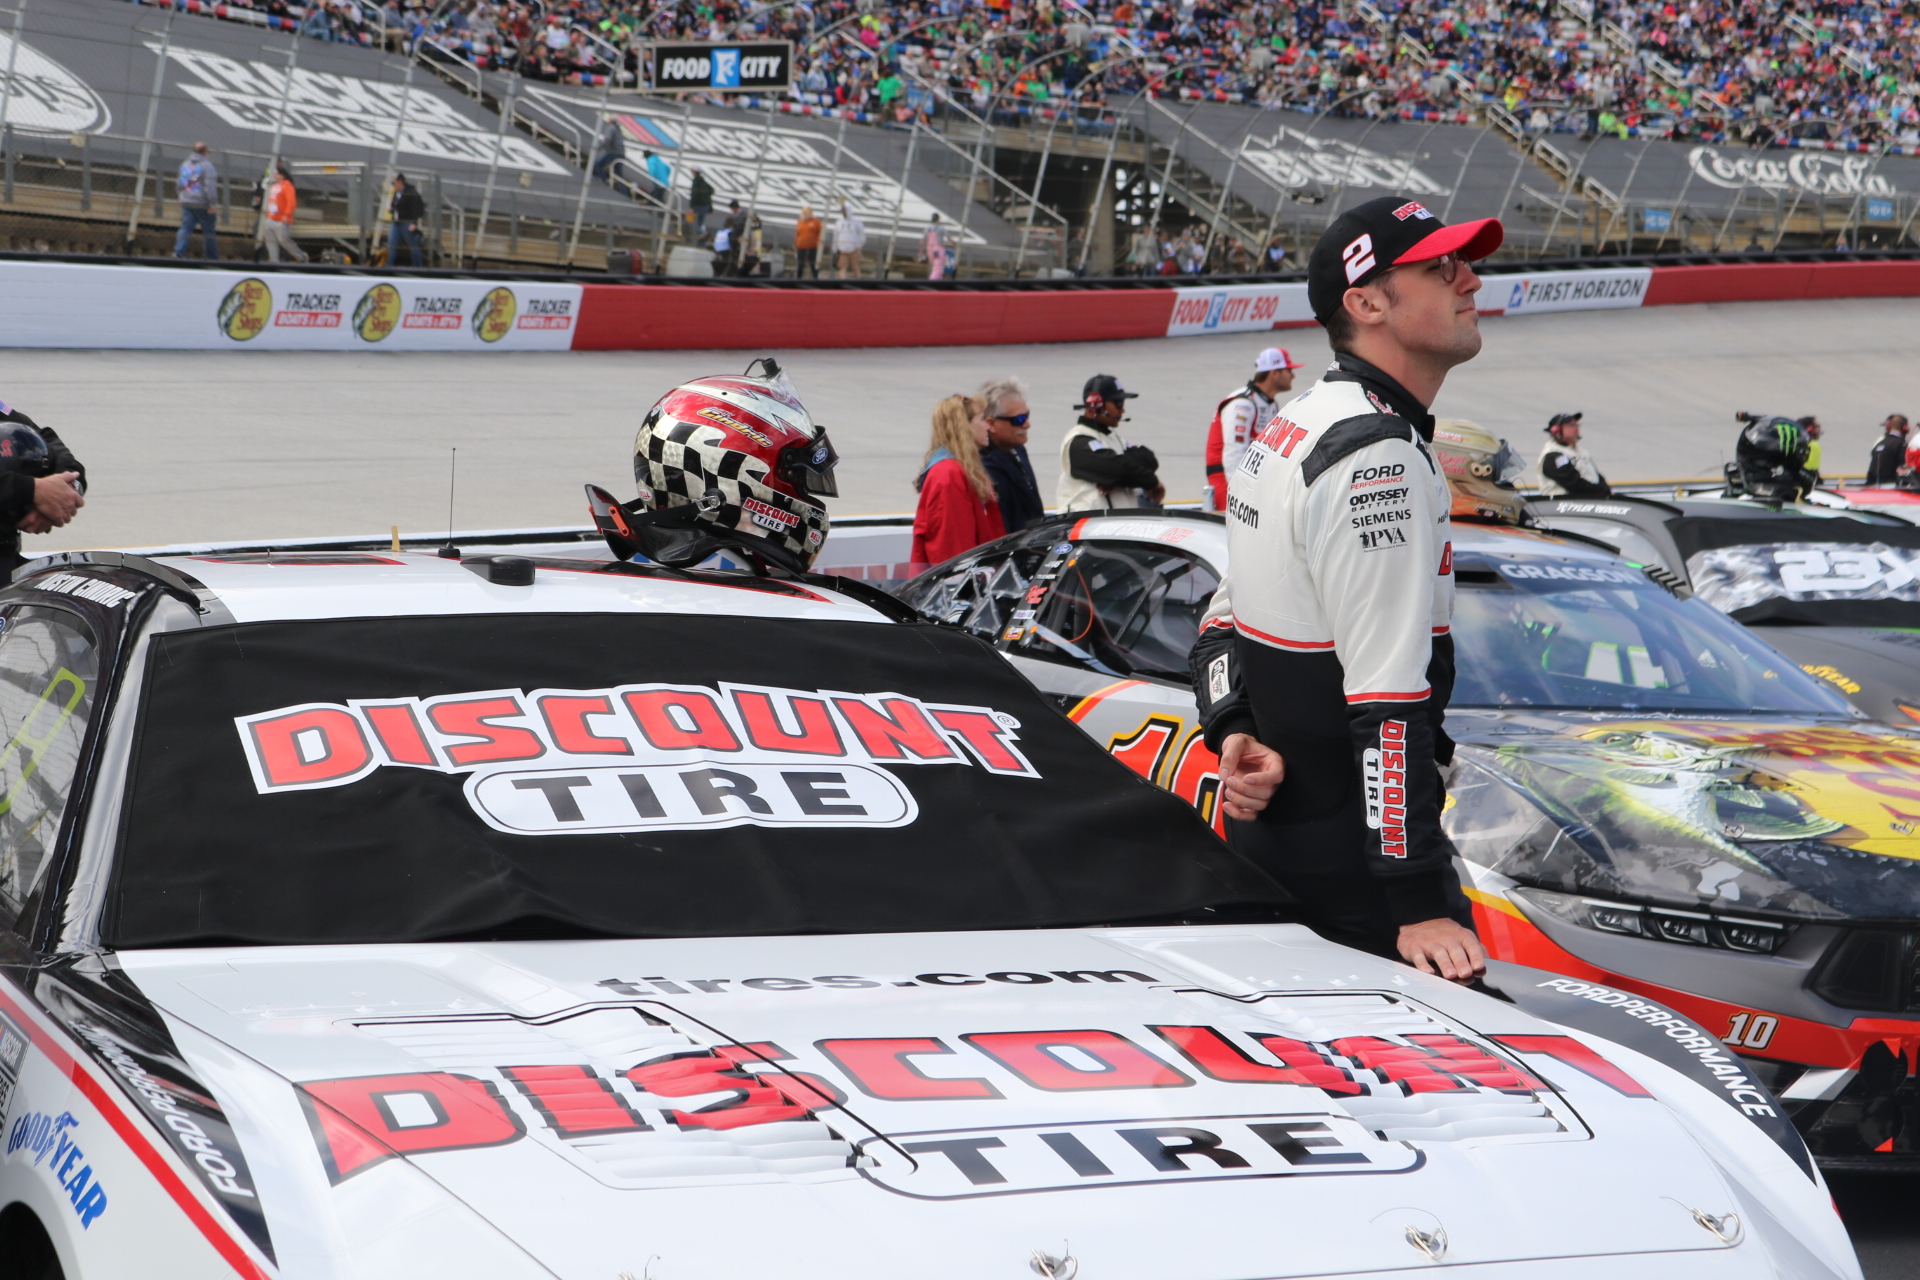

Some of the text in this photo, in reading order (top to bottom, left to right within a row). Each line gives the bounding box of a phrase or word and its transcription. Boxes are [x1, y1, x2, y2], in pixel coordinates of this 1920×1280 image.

[662, 56, 782, 80] FOOD CITY
[143, 42, 487, 131] TRACKER
[651, 118, 834, 169] NASCAR
[1241, 150, 1452, 197] BUSCH
[1689, 147, 1897, 197] Coca-Cola
[1343, 233, 1376, 286] 2
[286, 293, 341, 311] TRACKER
[1527, 278, 1643, 303] FIRST HORIZON
[278, 313, 310, 325] BOATS
[413, 297, 462, 313] TRACKER
[527, 300, 571, 314] TRACKER
[1173, 296, 1279, 325] FOOD CITY 500
[1350, 476, 1405, 490] PERFORMANCE
[1351, 463, 1405, 483] FORD
[1349, 487, 1409, 507] ODYSSEY
[1351, 498, 1407, 513] BATTERY
[1567, 503, 1595, 513] TYLER
[743, 497, 800, 529] DISCOUNT
[757, 515, 782, 530] TIRE
[1351, 509, 1412, 529] SIEMENS
[1369, 527, 1407, 548] PVA
[1500, 564, 1644, 585] GRAGSON
[34, 573, 137, 609] AUSTIN CINDRIC
[239, 688, 1040, 791] DISCOUNT
[511, 770, 869, 823] TIRE
[1366, 758, 1379, 818] TIRE
[1381, 719, 1407, 858] DISCOUNT
[596, 969, 1161, 997] tires.com
[1719, 1011, 1780, 1051] 10
[1536, 978, 1777, 1118] FORDPERFORMANCE
[898, 1122, 1373, 1186] TIRE
[7, 1111, 108, 1231] GOODYEAR
